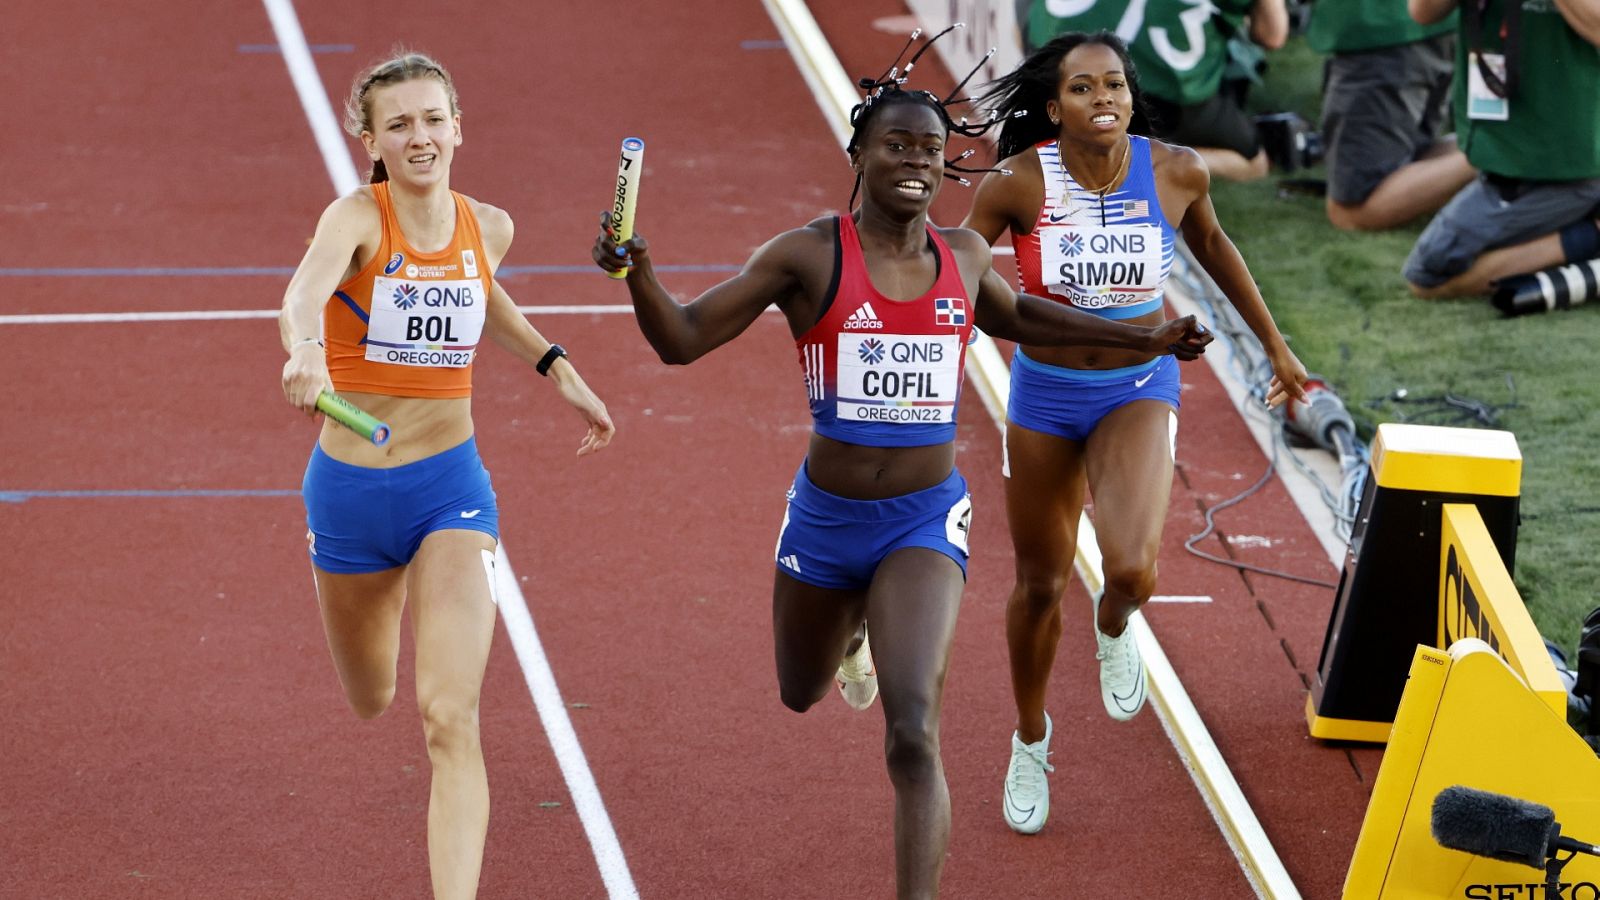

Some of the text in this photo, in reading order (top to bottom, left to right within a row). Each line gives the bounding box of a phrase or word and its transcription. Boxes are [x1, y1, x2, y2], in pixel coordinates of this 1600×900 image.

[611, 175, 628, 246] OREGON2
[1090, 234, 1145, 254] QNB
[1059, 262, 1145, 286] SIMON
[424, 287, 474, 308] QNB
[1065, 289, 1136, 307] OREGON22
[406, 316, 459, 342] BOL
[843, 319, 884, 329] adidas
[387, 350, 470, 366] OREGON22
[891, 342, 943, 363] QNB
[862, 370, 939, 398] COFIL
[857, 406, 941, 421] OREGON22
